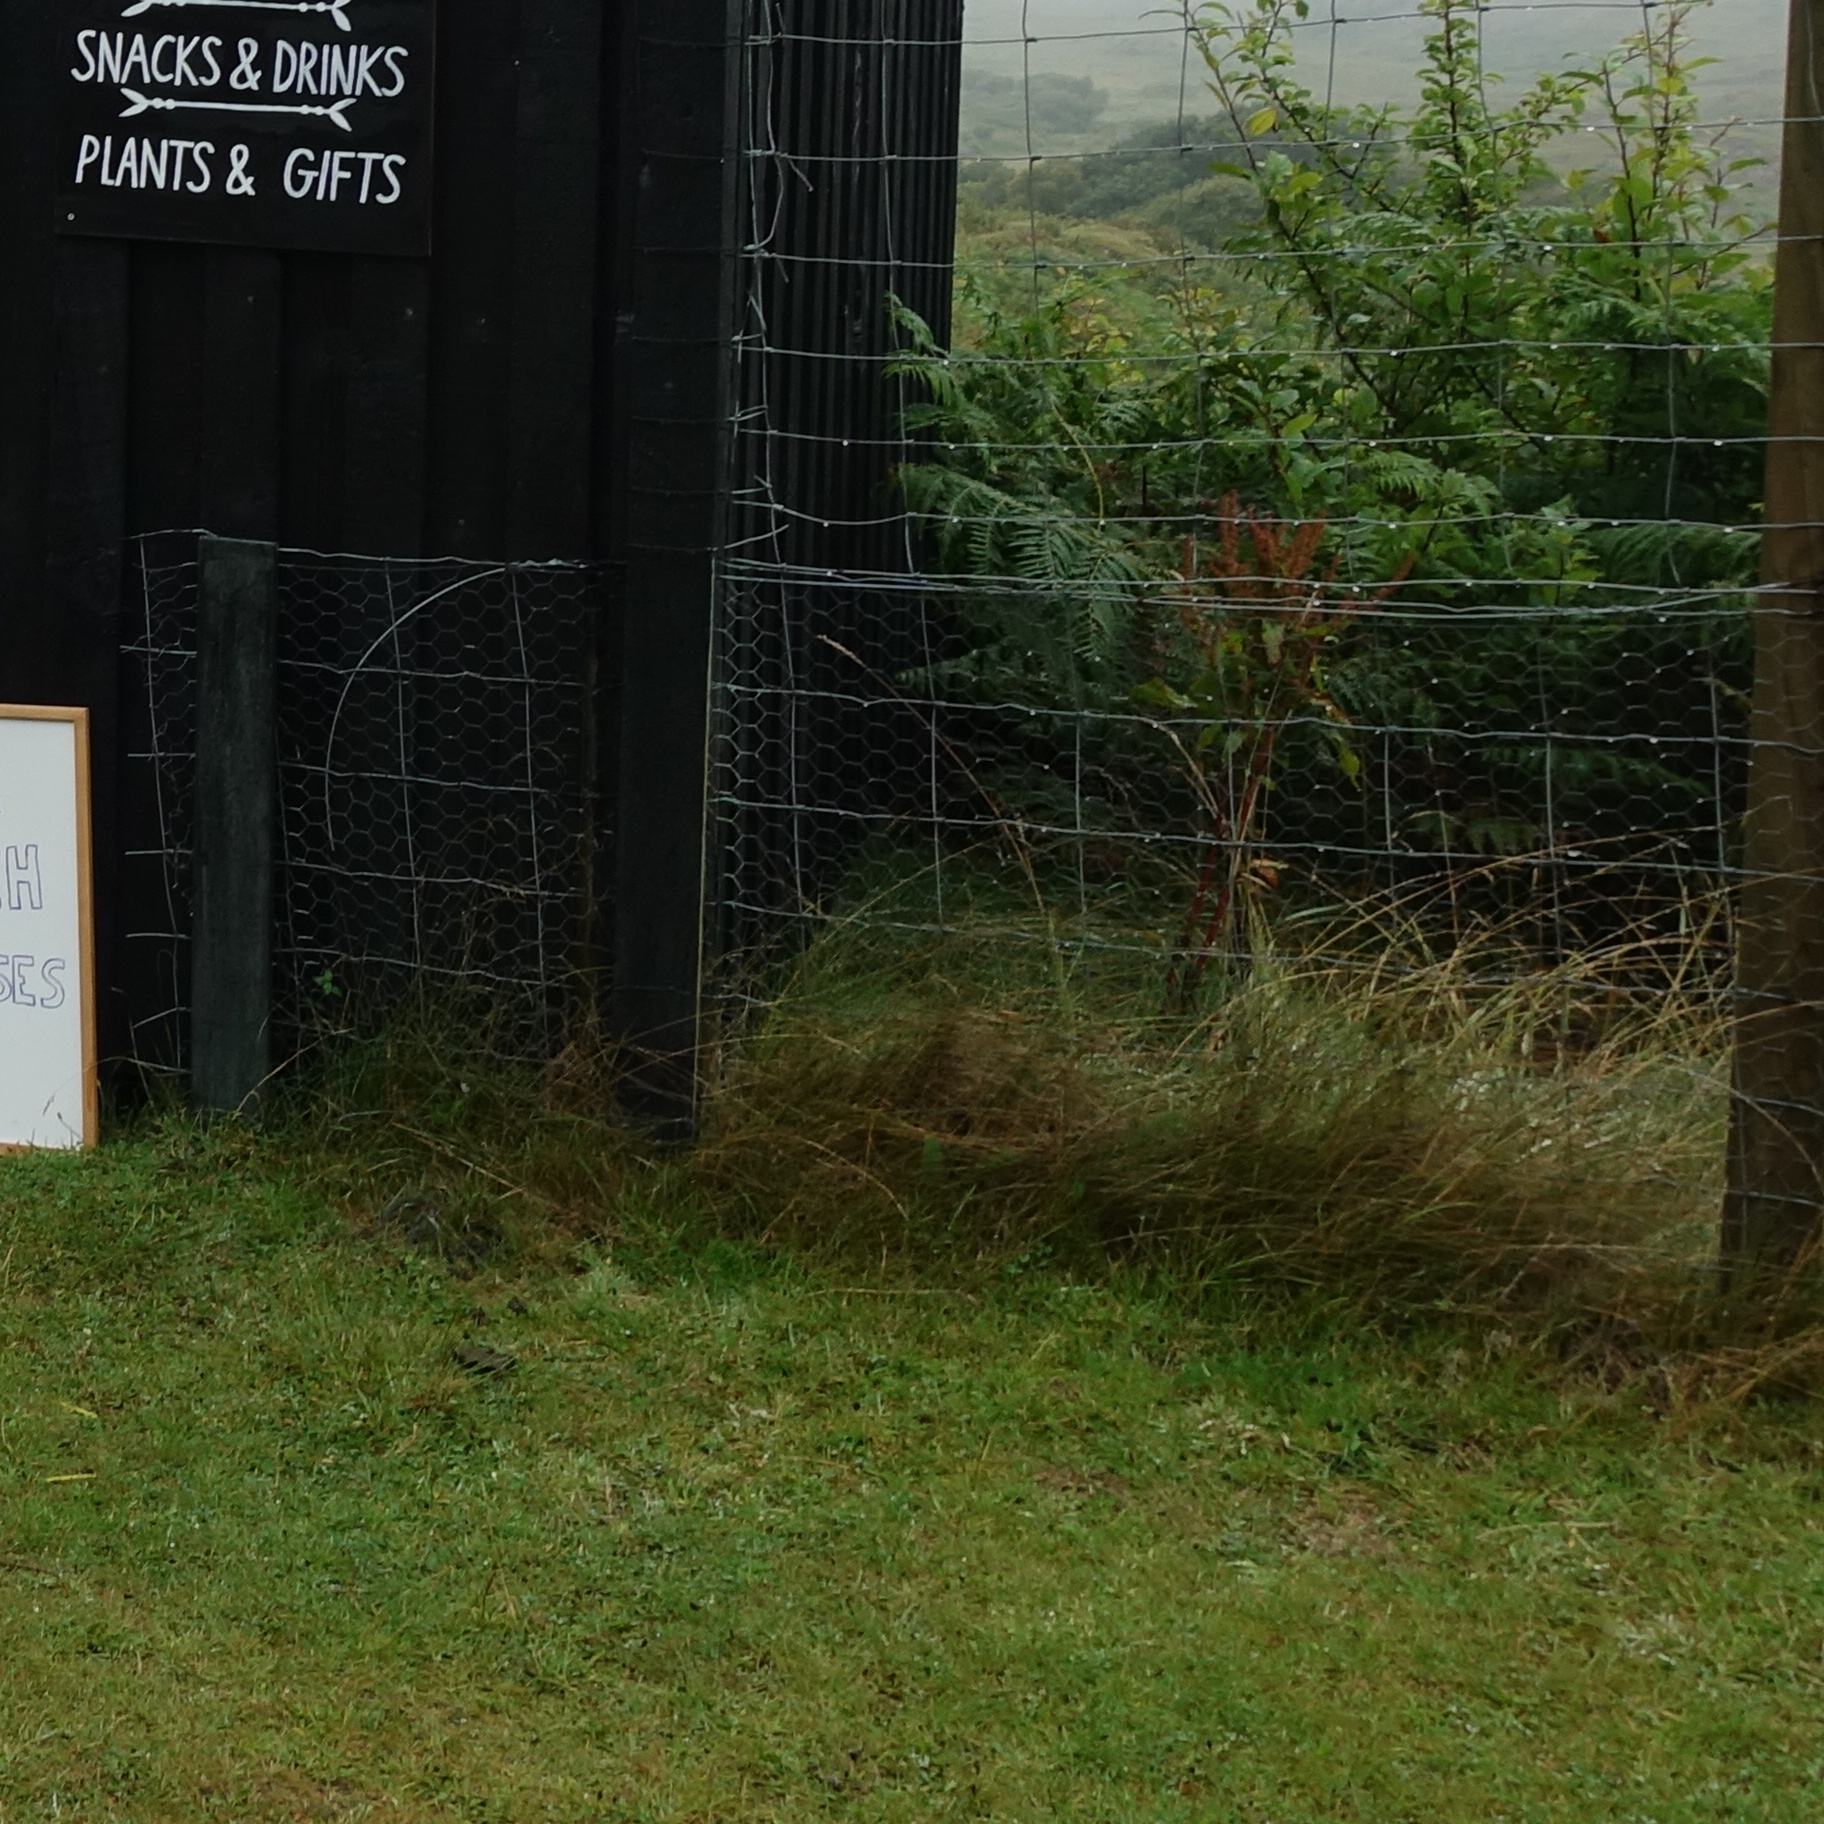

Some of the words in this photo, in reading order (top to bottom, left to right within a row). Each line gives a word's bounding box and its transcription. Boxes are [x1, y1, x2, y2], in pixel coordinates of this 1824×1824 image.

[71, 29, 223, 87] SNACKS
[229, 37, 262, 91] &
[272, 39, 409, 97] DRINKS
[75, 134, 216, 193] PLANTS
[225, 143, 256, 196] &
[283, 147, 406, 204] GIFTS
